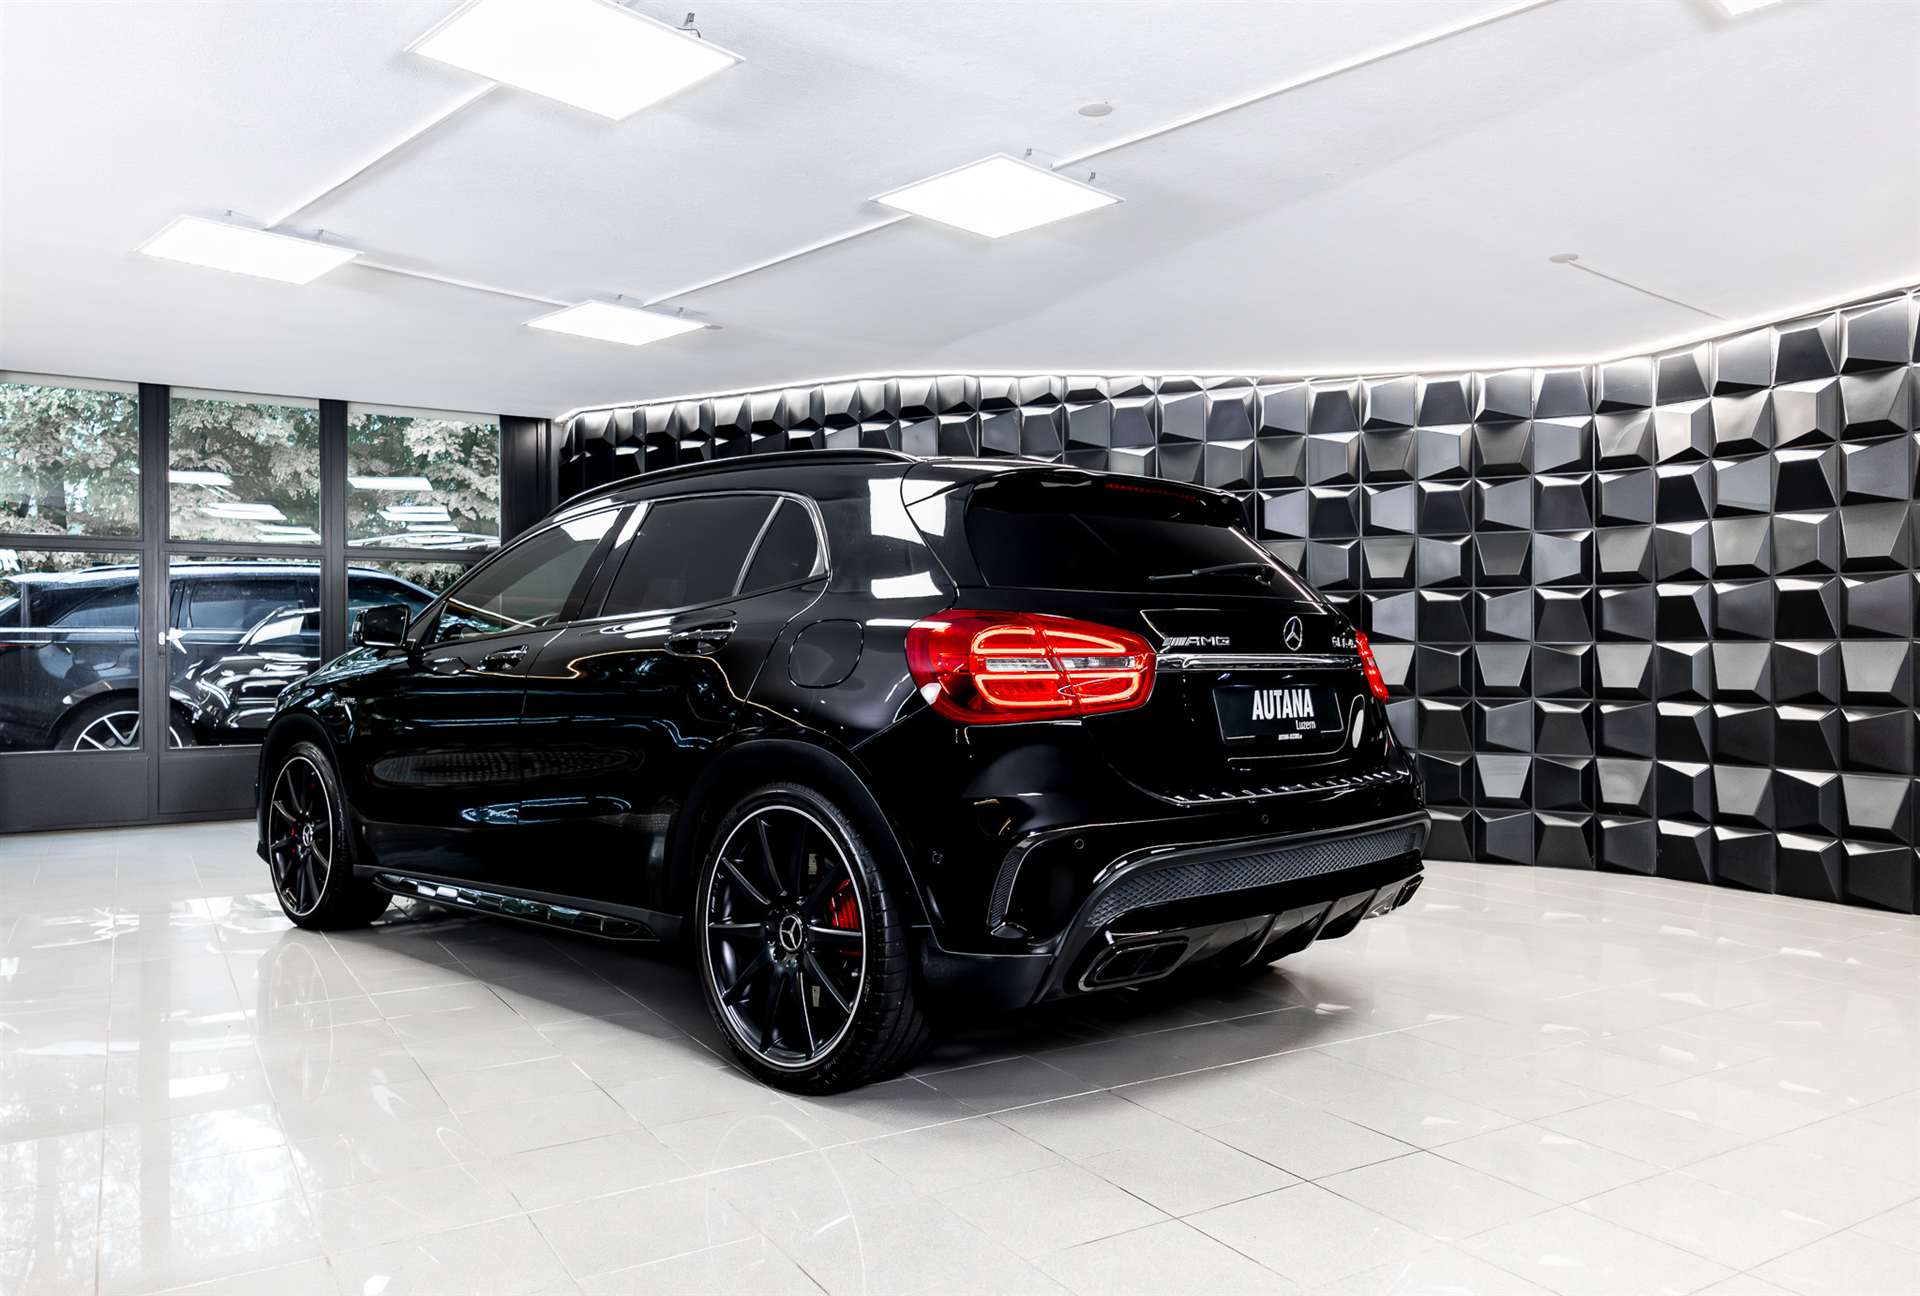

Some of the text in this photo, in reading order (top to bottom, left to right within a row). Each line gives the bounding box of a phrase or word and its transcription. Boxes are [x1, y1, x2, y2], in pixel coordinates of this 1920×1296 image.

[1184, 636, 1230, 647] AMG
[1252, 688, 1315, 720] AUTANA
[1295, 719, 1317, 731] Luzern
